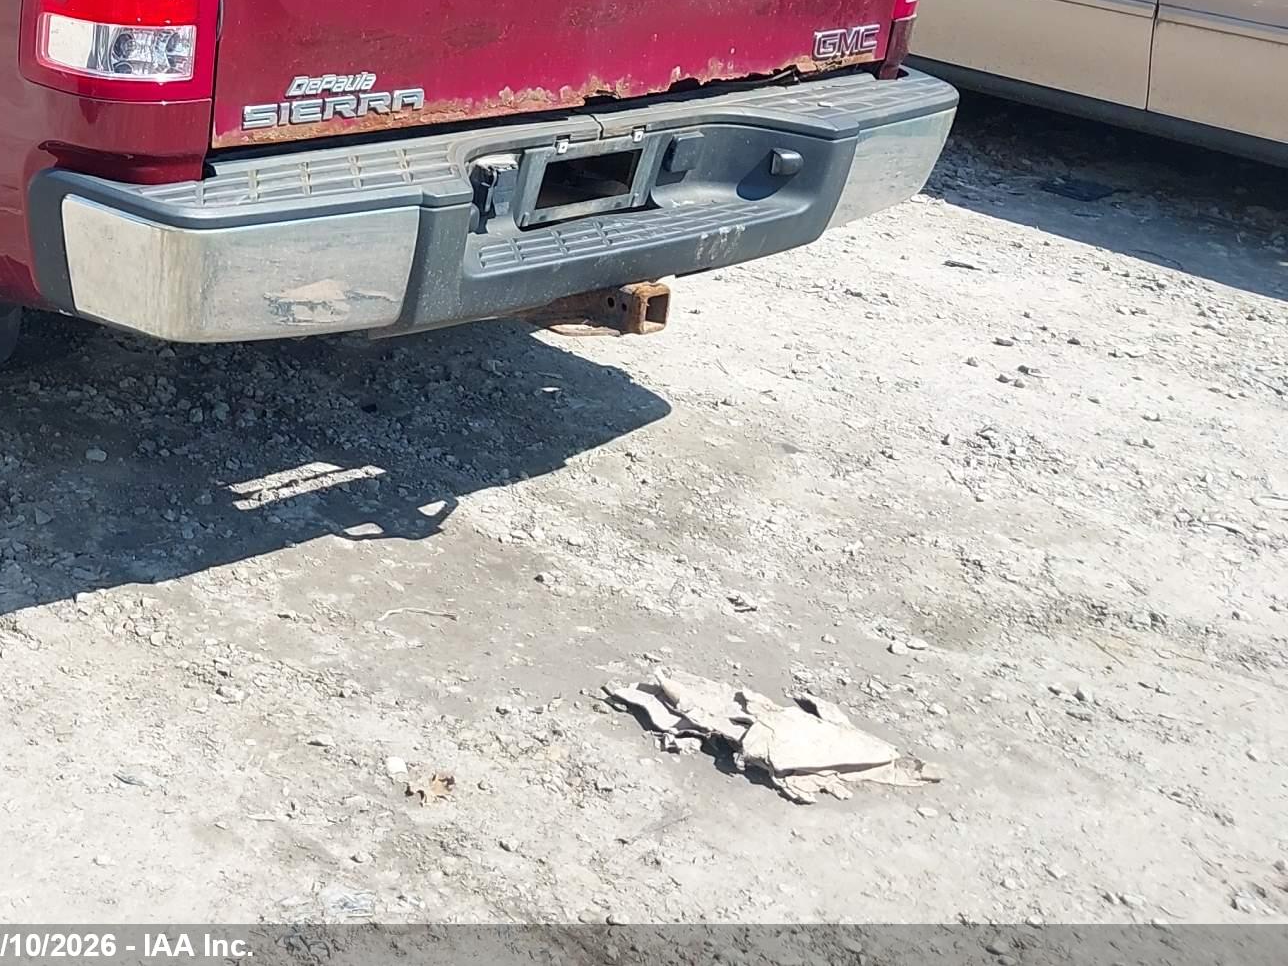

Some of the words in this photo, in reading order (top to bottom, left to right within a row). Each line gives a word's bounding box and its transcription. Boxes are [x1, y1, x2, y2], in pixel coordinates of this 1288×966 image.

[812, 23, 880, 60] GMC
[285, 71, 377, 97] DePaula
[242, 88, 425, 130] SIERRA
